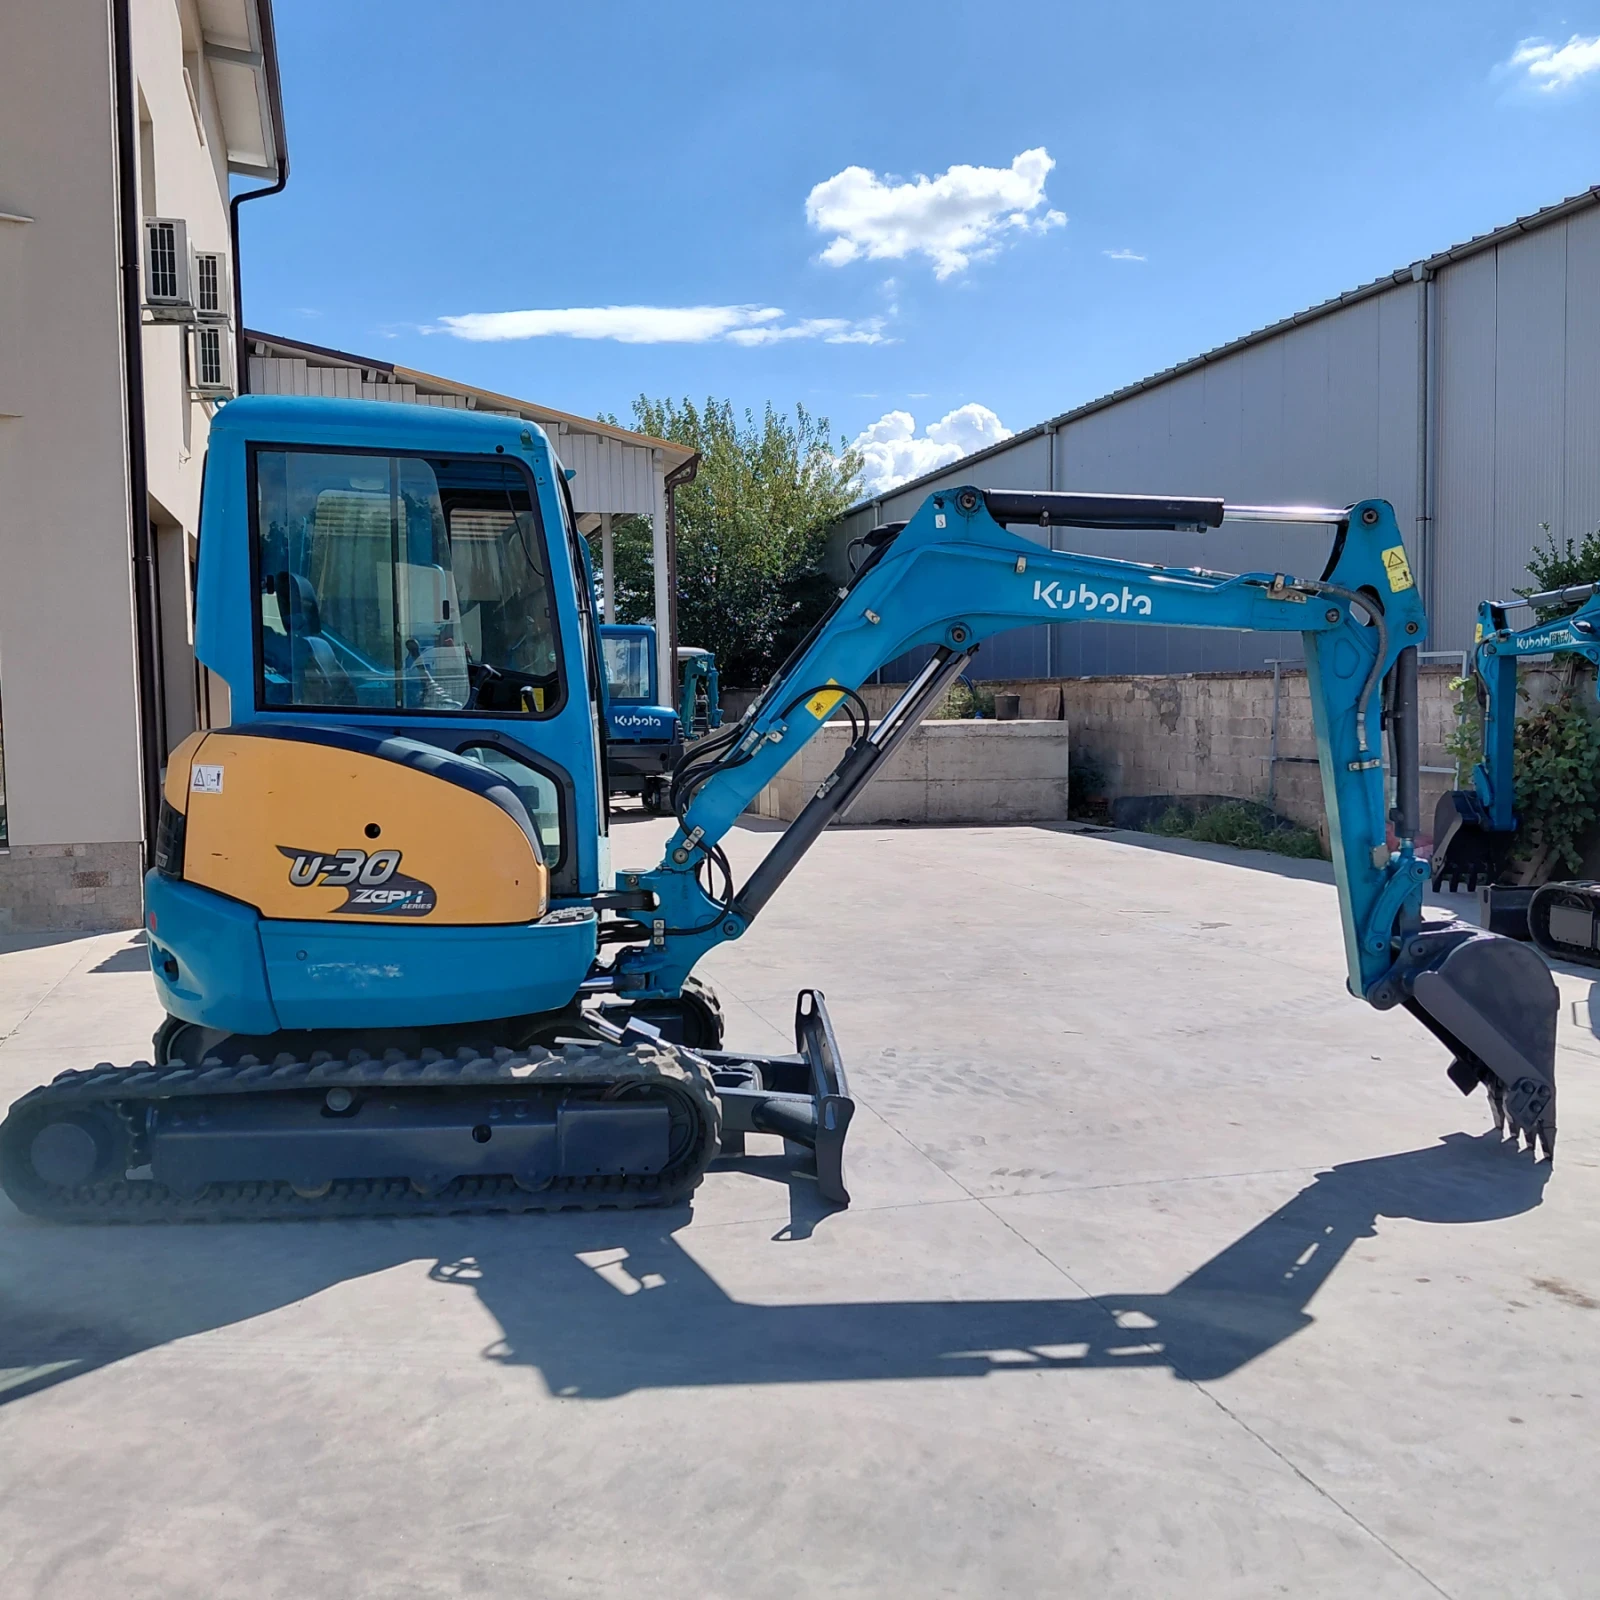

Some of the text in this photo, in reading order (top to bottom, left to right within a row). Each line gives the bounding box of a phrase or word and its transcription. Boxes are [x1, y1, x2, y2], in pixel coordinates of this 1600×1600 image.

[1033, 580, 1152, 615] Kubota
[1516, 634, 1551, 650] Kubota
[614, 714, 661, 726] Kubota
[289, 849, 401, 886] U-30
[400, 902, 432, 910] SERIES
